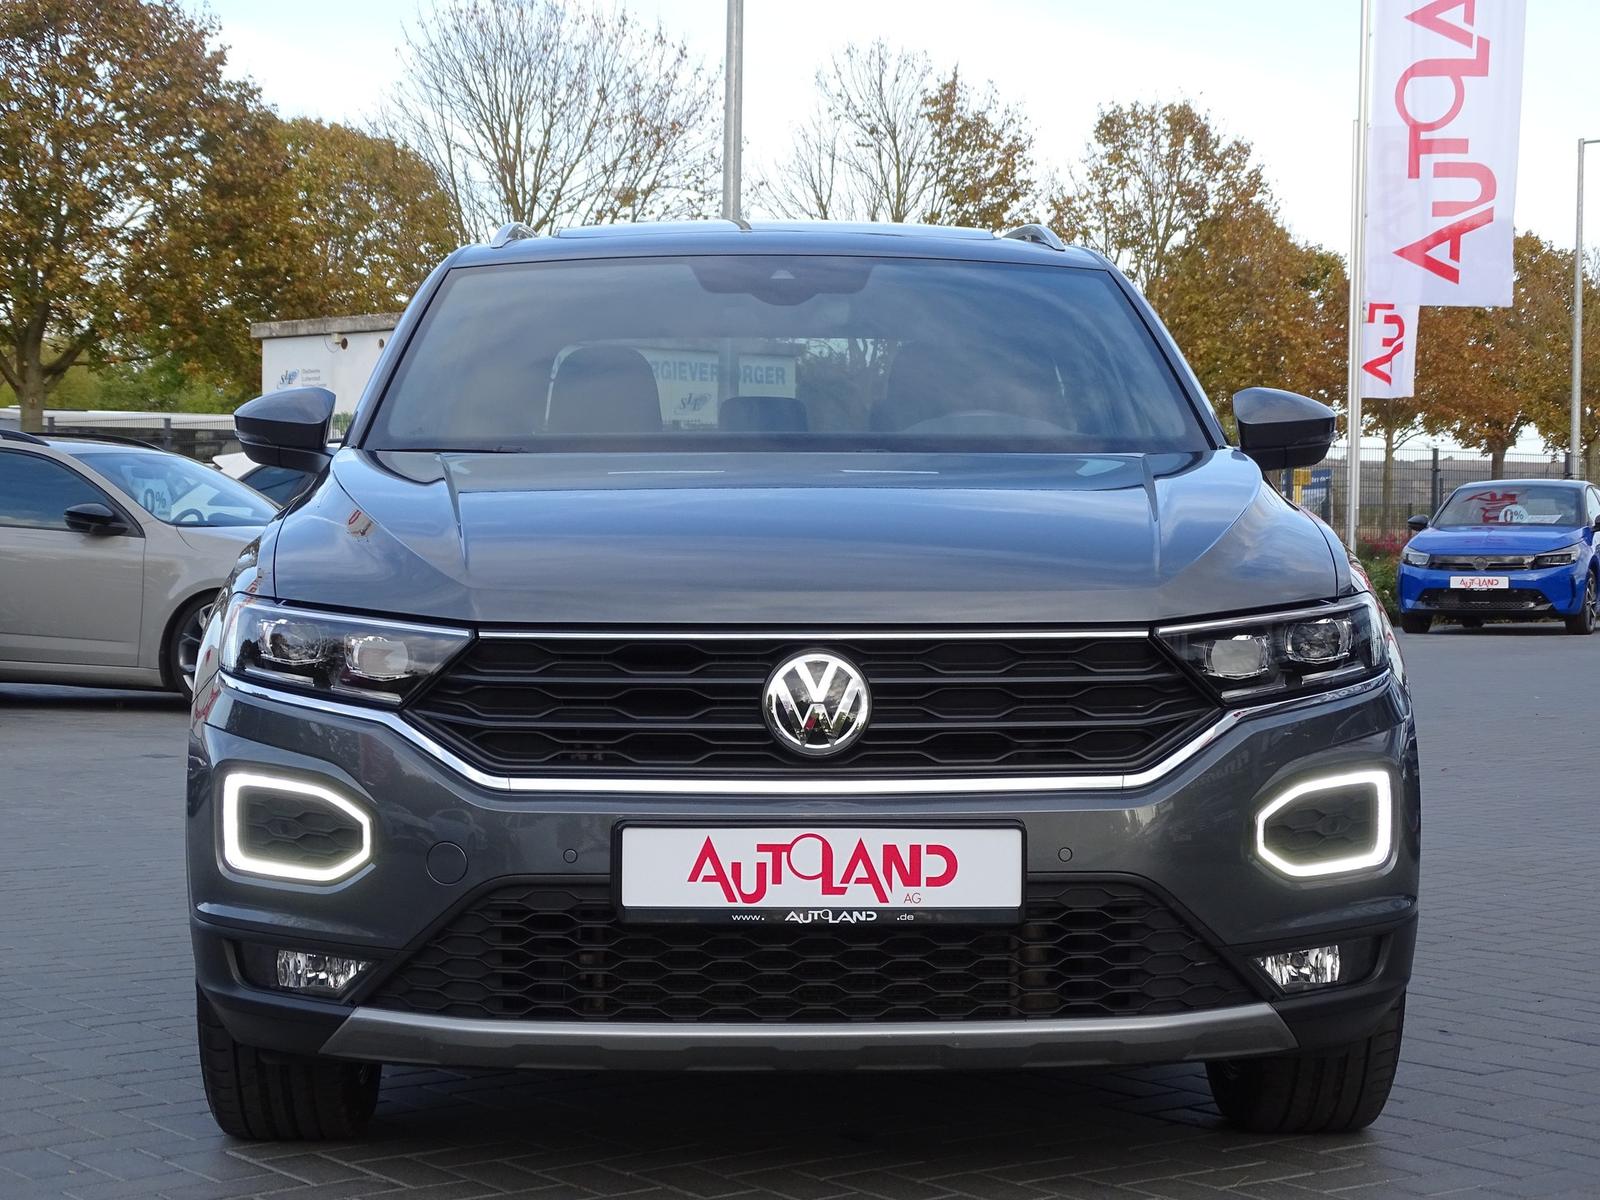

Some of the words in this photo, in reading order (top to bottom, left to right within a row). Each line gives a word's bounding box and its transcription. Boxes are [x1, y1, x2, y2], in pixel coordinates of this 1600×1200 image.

[687, 832, 958, 904] AUTOLAND
[903, 892, 922, 904] AG
[731, 913, 765, 921] www.
[785, 909, 877, 923] AUTOLAND
[896, 913, 914, 921] .de
